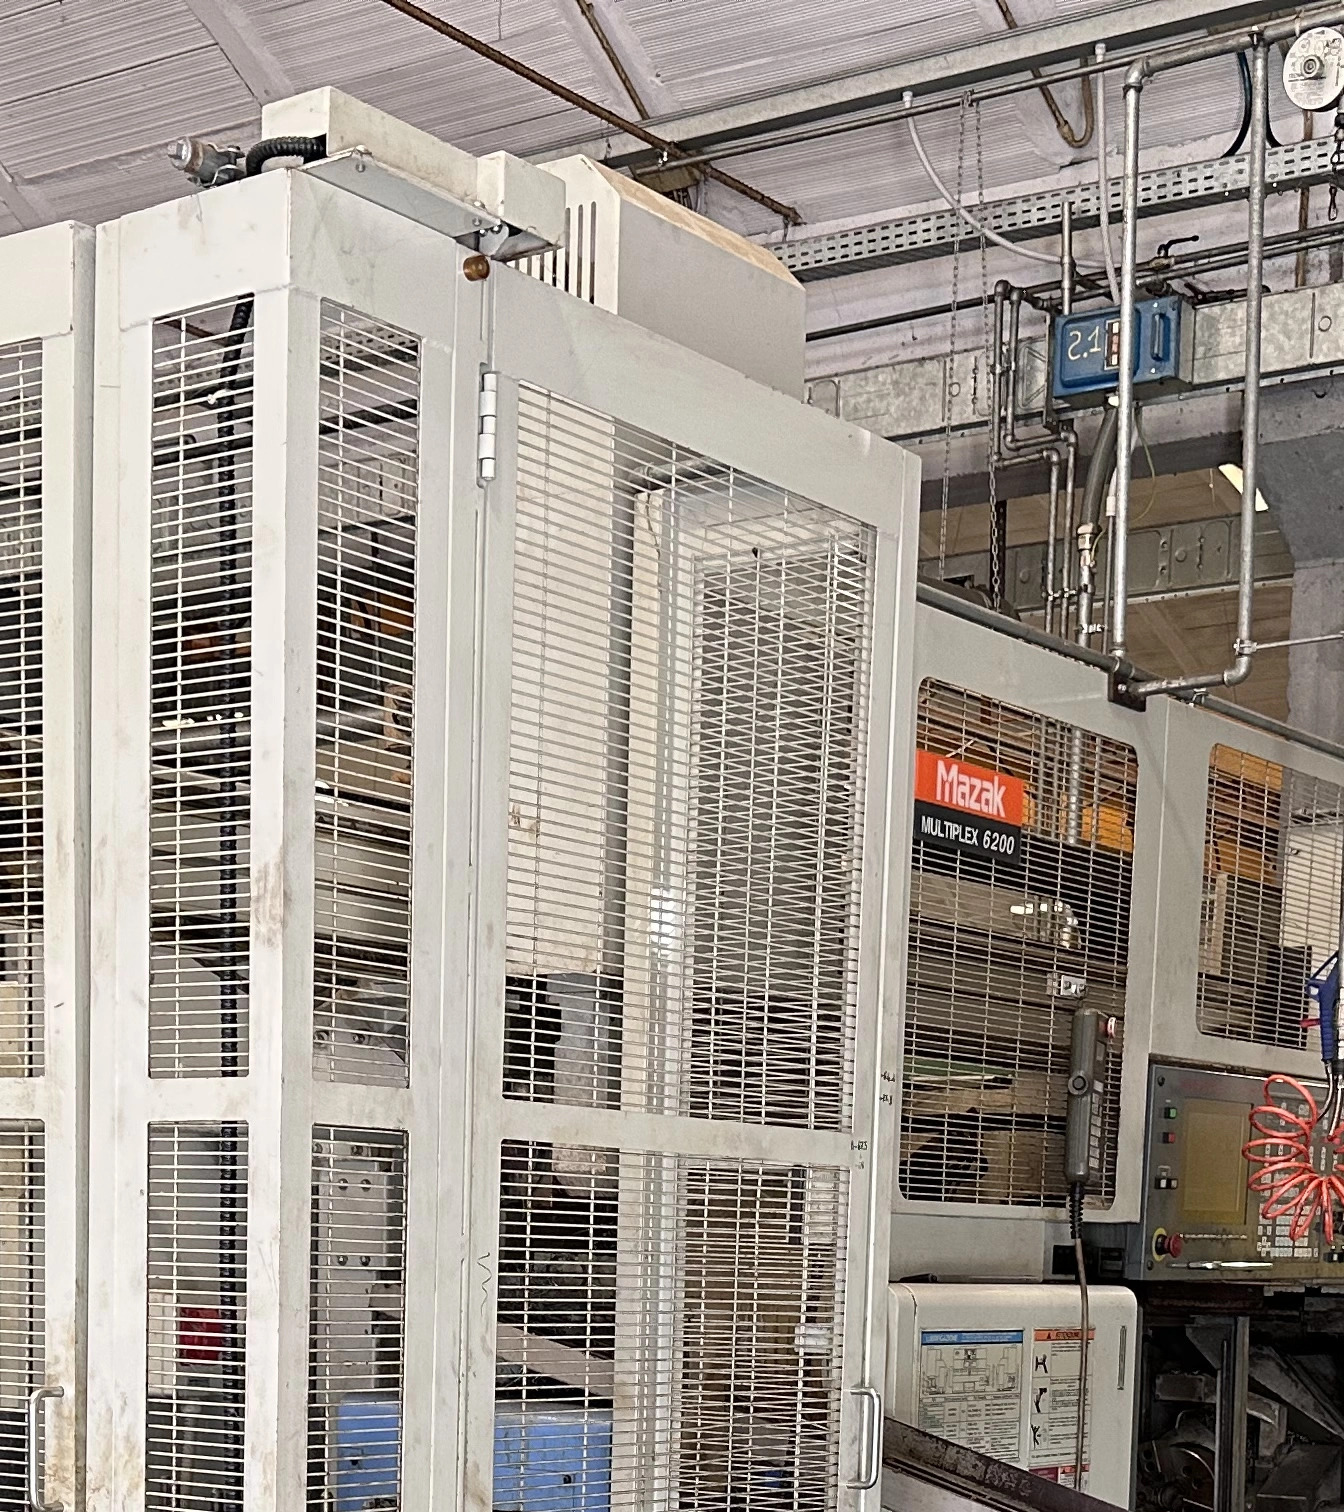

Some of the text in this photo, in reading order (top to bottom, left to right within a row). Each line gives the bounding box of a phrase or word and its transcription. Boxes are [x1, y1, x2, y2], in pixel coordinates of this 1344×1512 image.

[935, 759, 1007, 818] Mazak
[920, 815, 1016, 857] MULTIPLEX 6200
